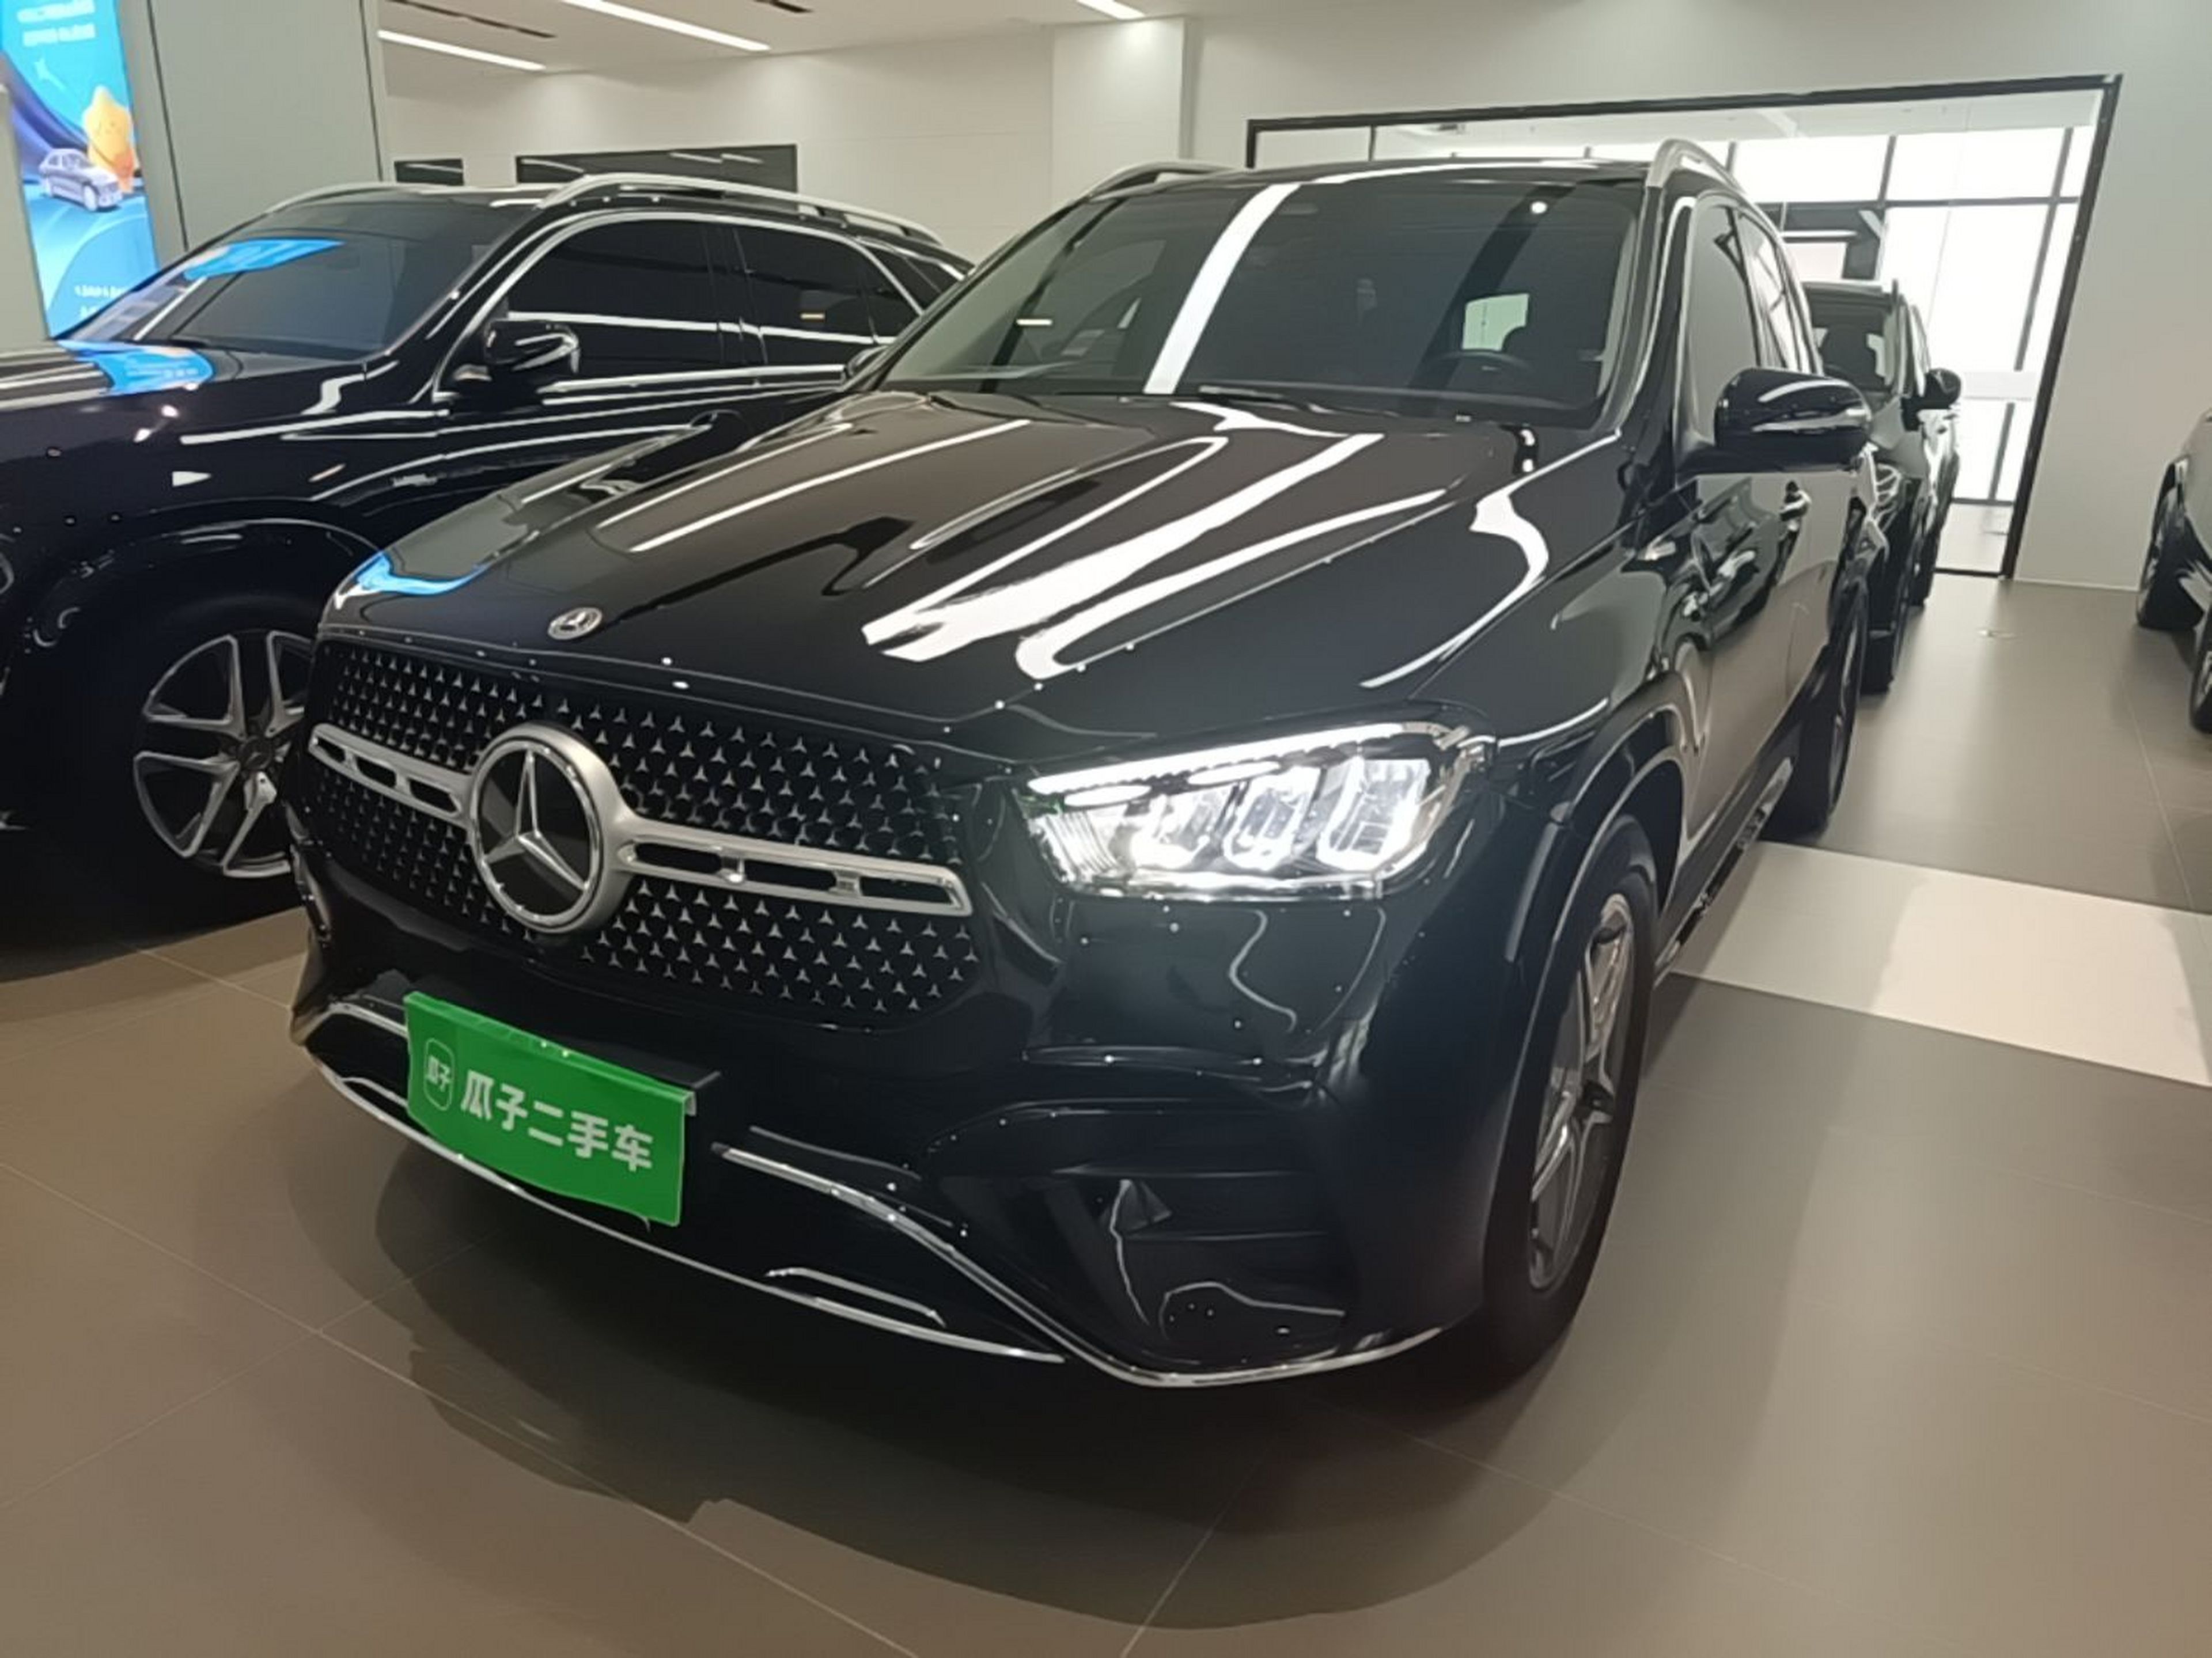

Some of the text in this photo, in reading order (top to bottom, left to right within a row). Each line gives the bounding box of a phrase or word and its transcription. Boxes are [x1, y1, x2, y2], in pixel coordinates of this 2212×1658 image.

[460, 1069, 653, 1172] 瓜子二手车
